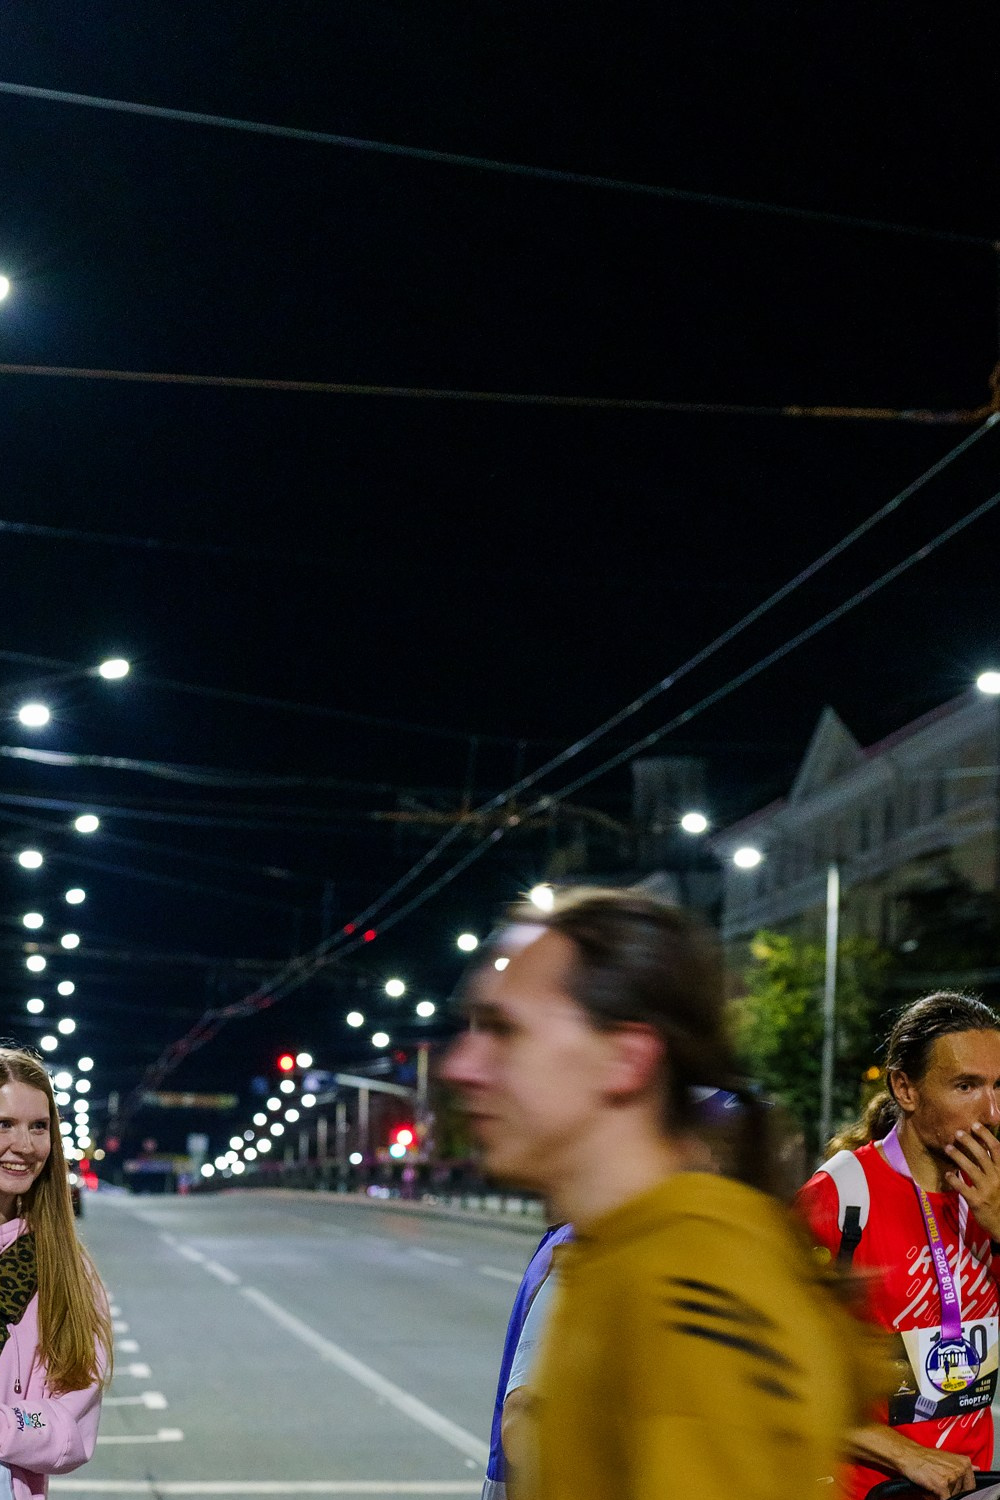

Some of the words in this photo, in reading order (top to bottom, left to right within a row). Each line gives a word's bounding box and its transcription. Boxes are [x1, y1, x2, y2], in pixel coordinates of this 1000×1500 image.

[927, 1217, 940, 1243] ТВОЯ
[934, 1247, 956, 1305] 16.08.2025
[959, 1395, 981, 1407] СПОРТ
